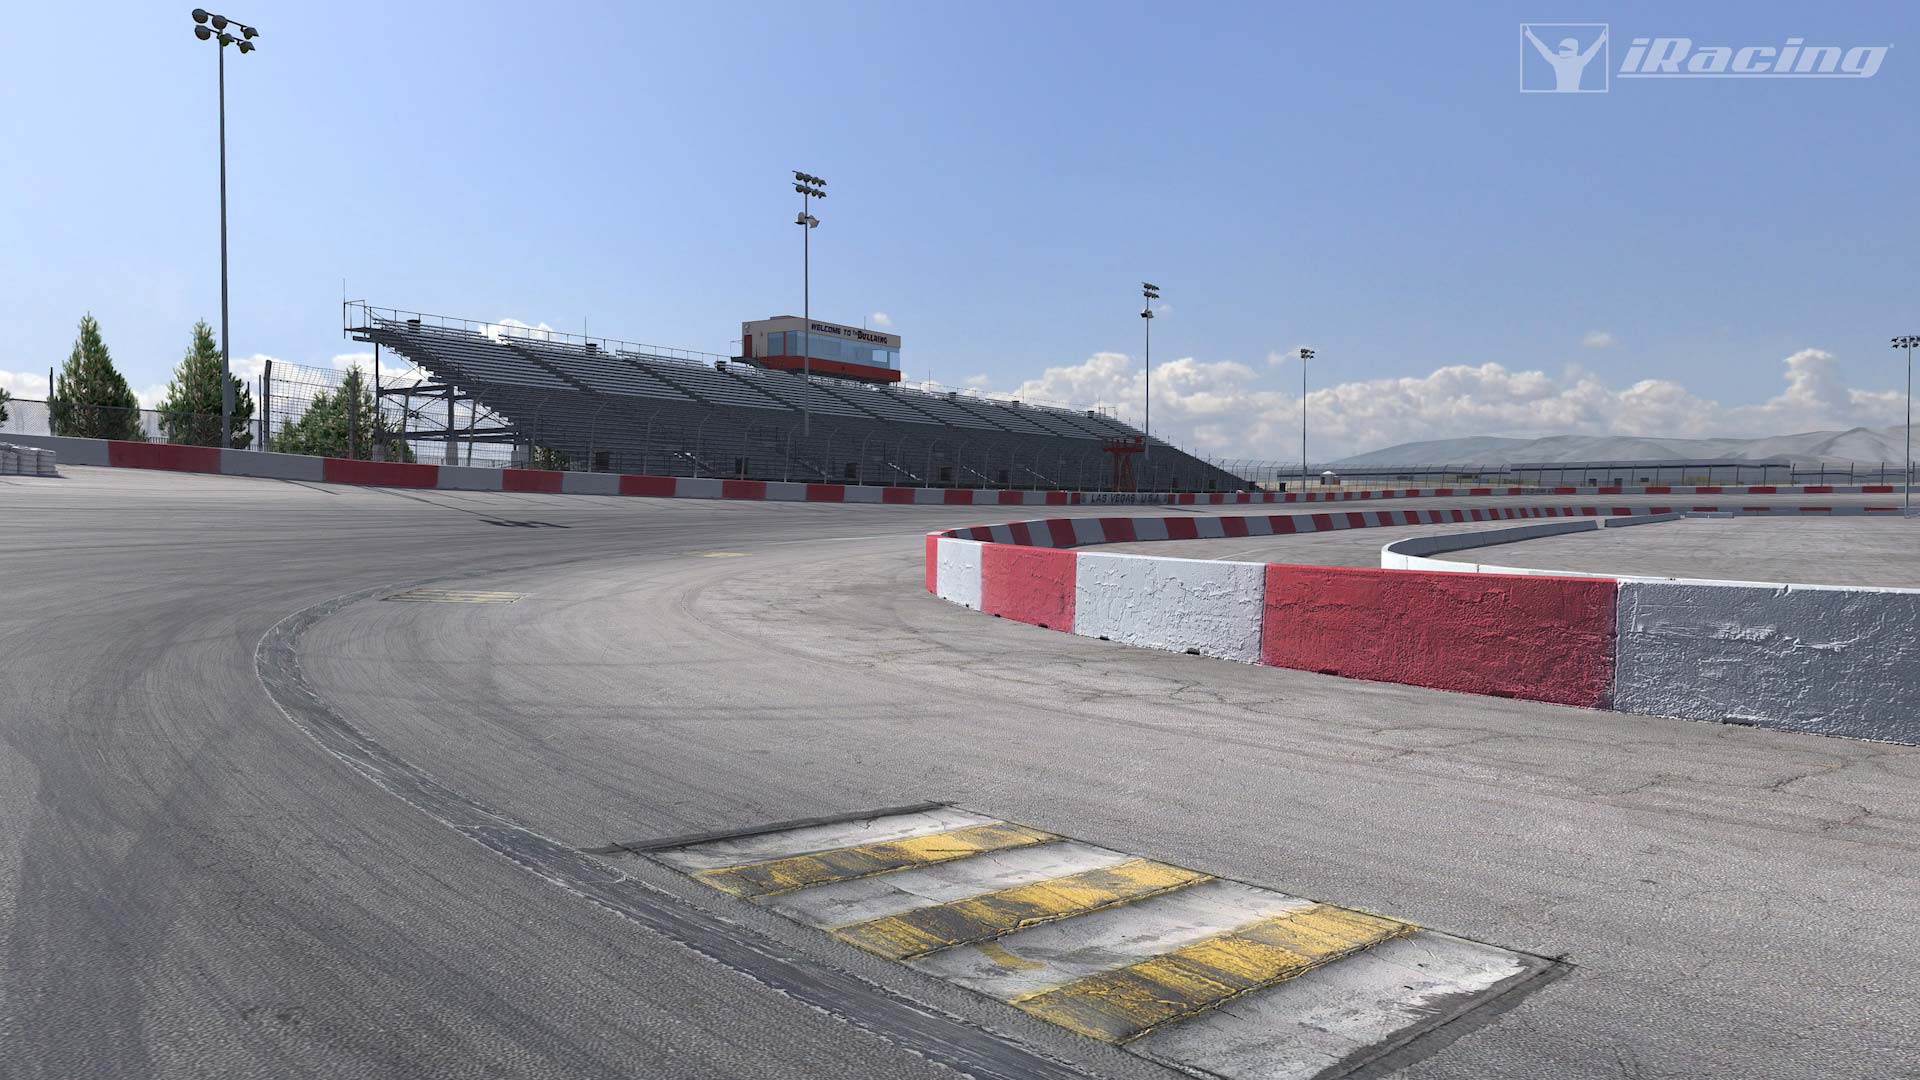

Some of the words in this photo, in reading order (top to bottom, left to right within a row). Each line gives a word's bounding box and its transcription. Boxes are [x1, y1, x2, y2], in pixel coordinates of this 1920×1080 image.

[811, 323, 841, 335] WELCOME
[844, 328, 851, 336] TO
[1091, 493, 1108, 505] LAS
